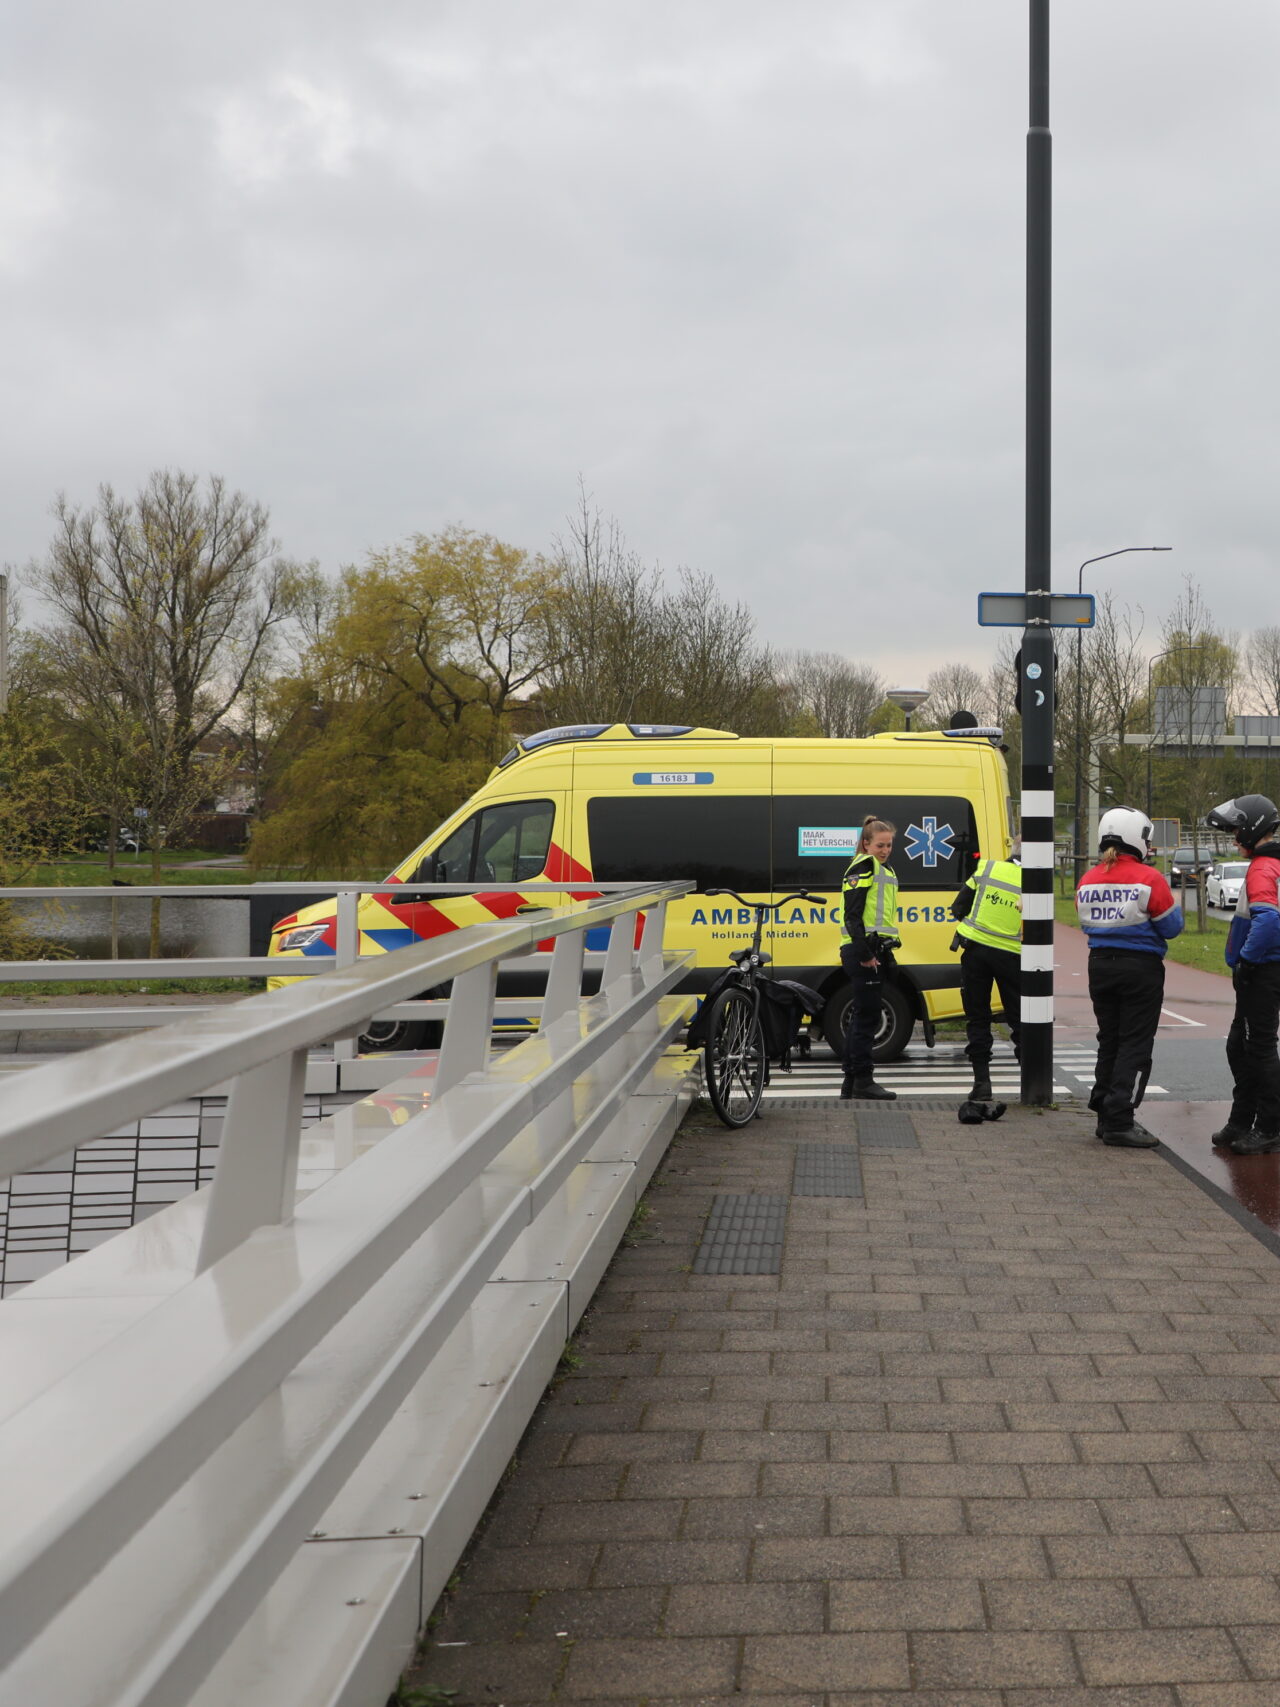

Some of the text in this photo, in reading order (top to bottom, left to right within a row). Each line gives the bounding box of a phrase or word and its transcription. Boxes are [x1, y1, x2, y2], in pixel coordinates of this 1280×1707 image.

[660, 774, 688, 783] 16183
[803, 831, 825, 839] MAAK
[803, 839, 817, 847] HET
[691, 907, 840, 925] AMBULANC
[1090, 906, 1126, 920] DICK
[766, 930, 809, 939] Midden
